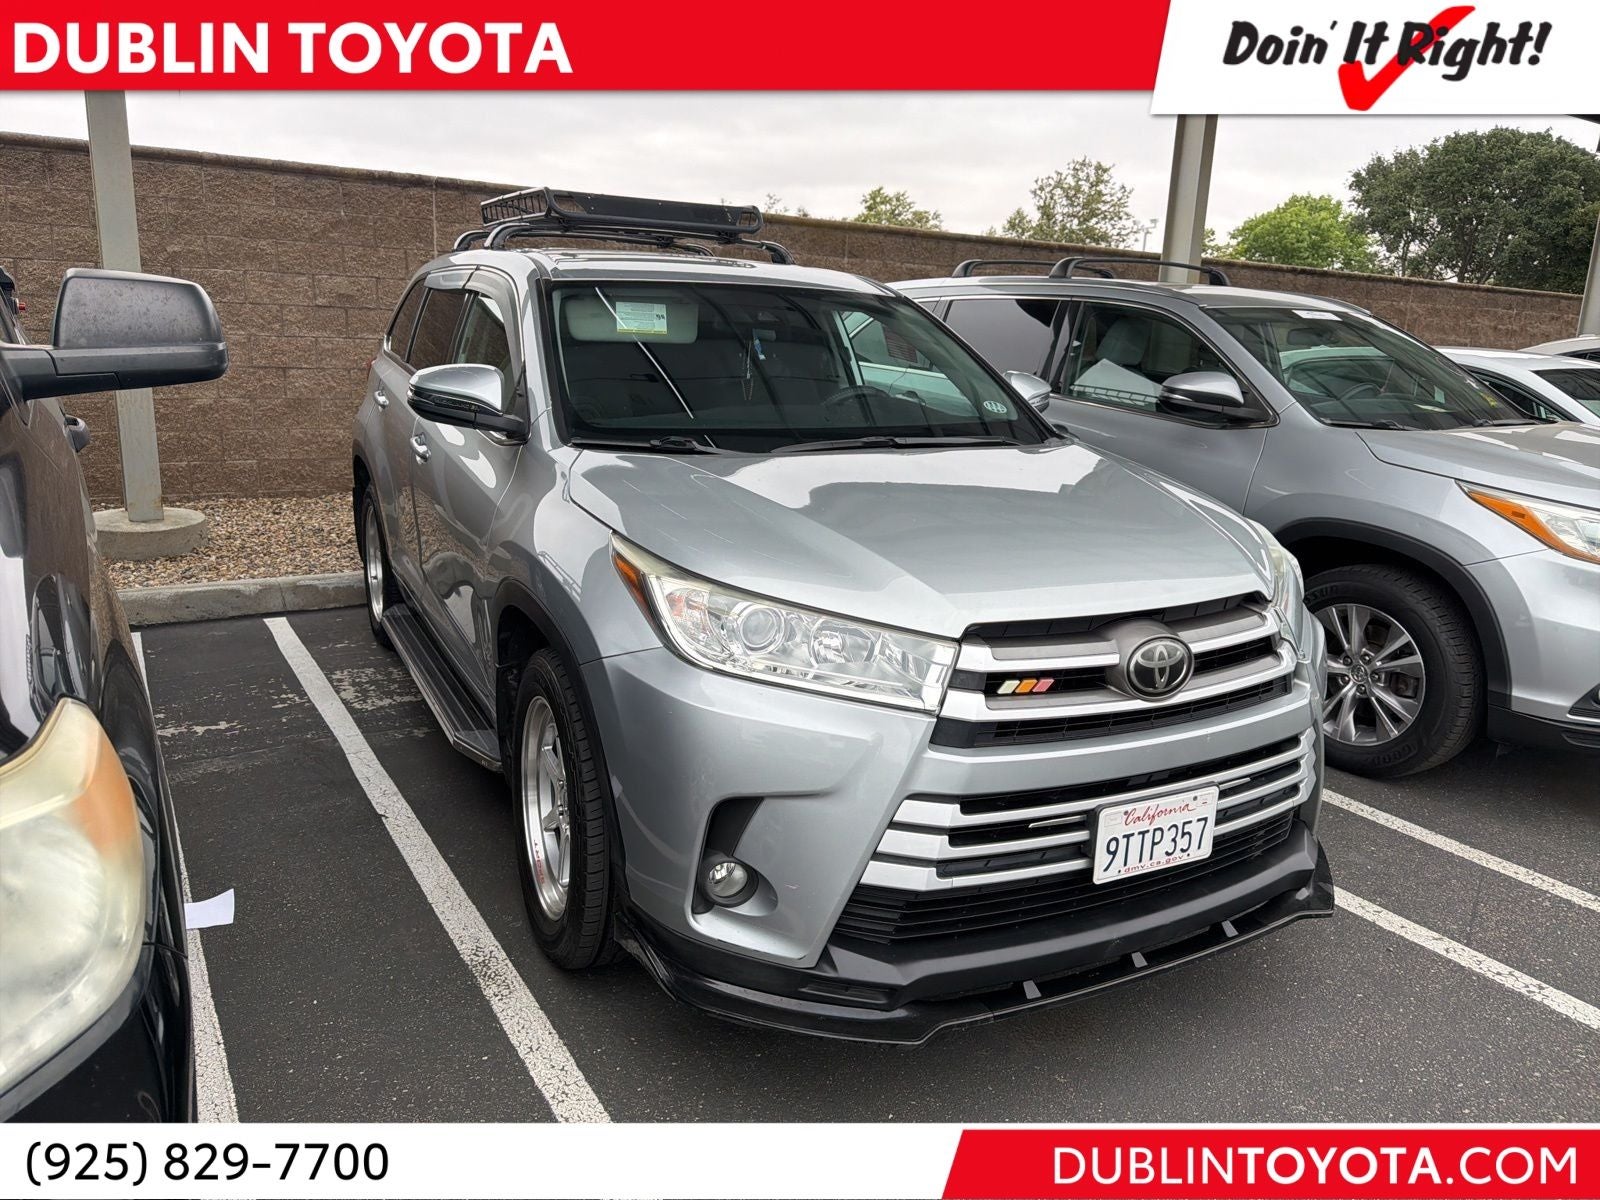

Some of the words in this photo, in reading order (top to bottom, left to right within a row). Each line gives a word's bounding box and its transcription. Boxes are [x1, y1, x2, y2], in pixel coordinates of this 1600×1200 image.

[1124, 802, 1196, 826] California
[1103, 816, 1209, 873] 9TTP357
[1124, 854, 1184, 874] dmv.ca.gov
